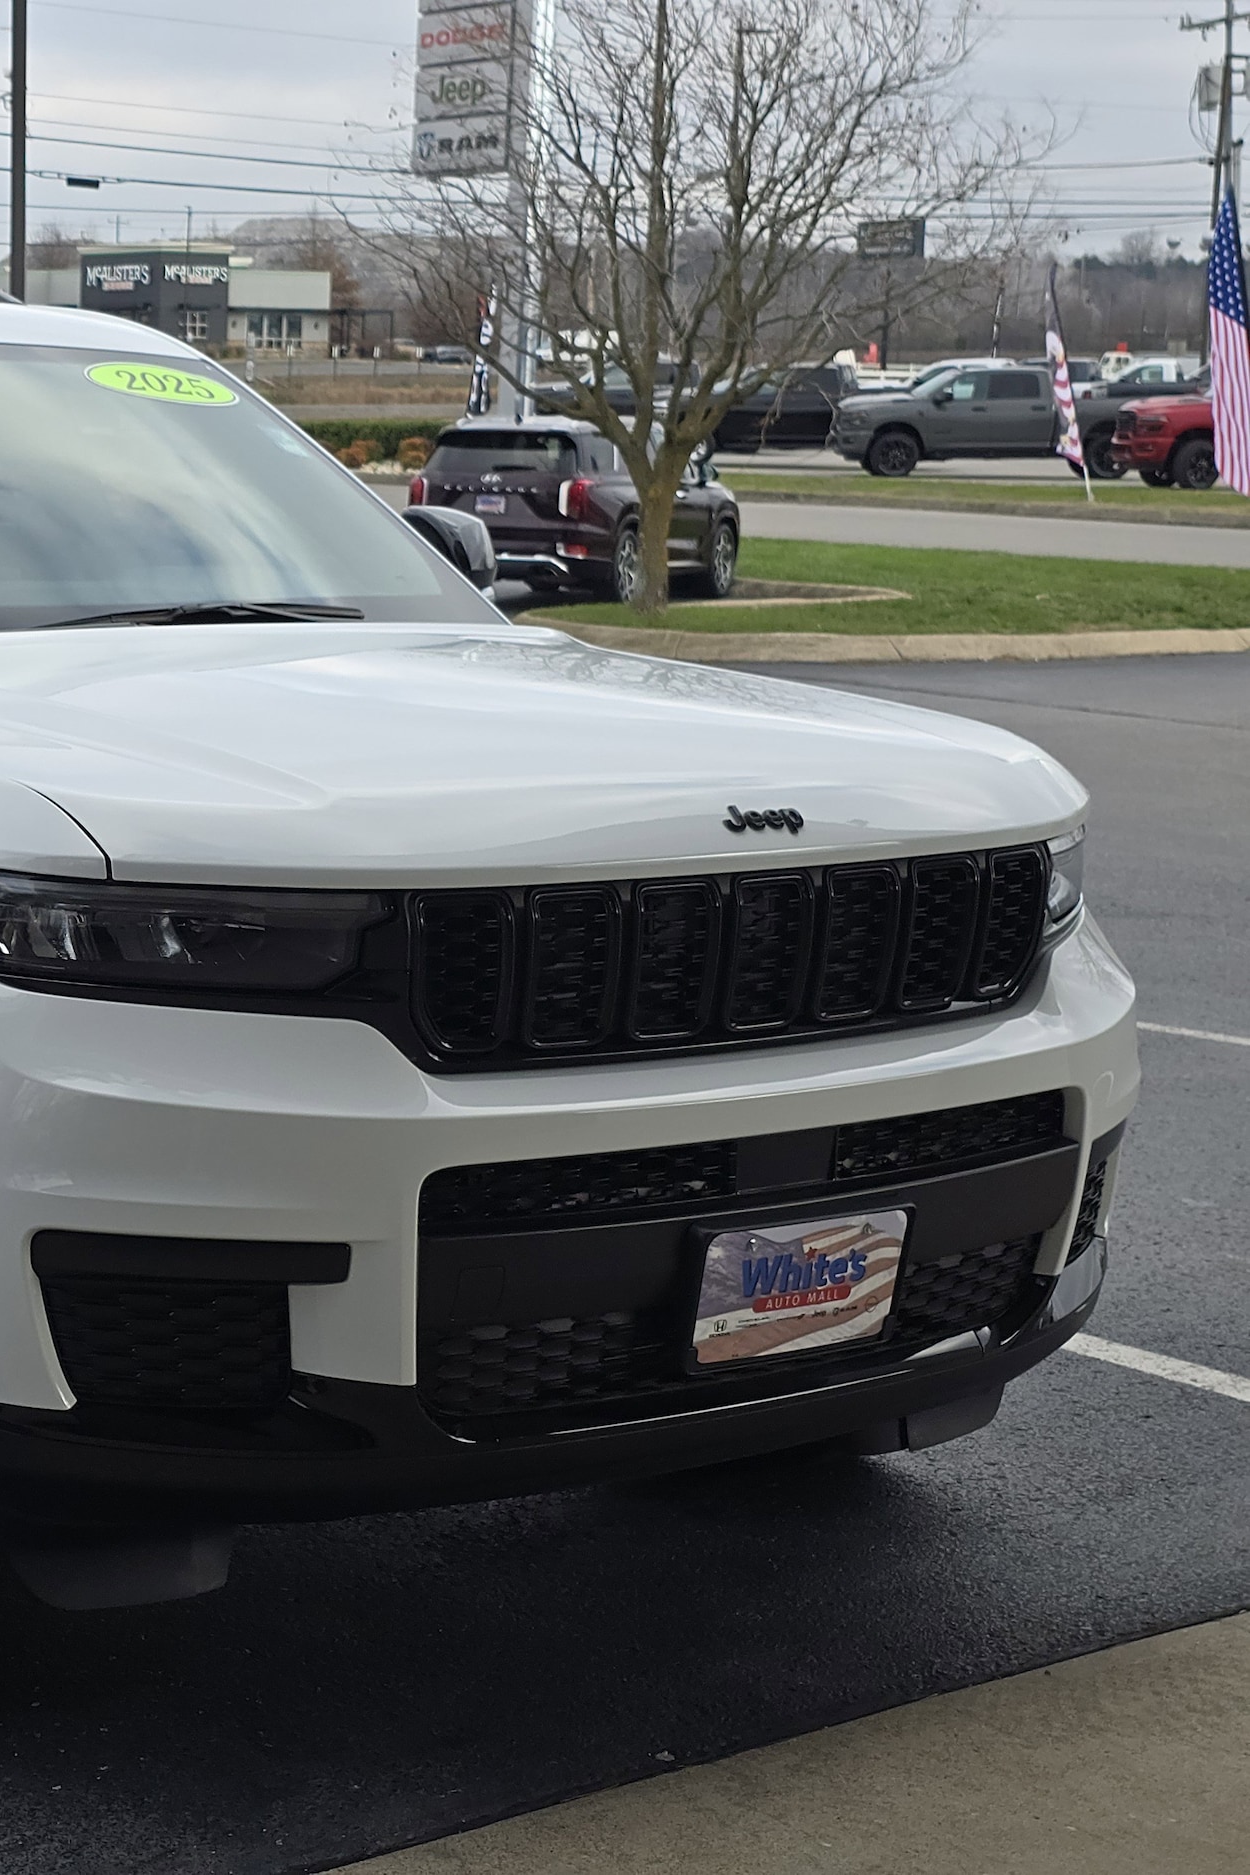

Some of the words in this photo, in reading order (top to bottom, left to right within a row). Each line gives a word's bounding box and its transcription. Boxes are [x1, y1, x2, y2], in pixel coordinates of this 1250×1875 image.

[421, 23, 506, 48] DODGE
[431, 75, 487, 105] Jeep
[438, 133, 499, 153] RAM
[115, 370, 215, 399] 2025
[722, 804, 804, 835] Jeep
[742, 1248, 868, 1298] White's
[766, 1296, 800, 1310] AUTO
[807, 1289, 838, 1303] MALL
